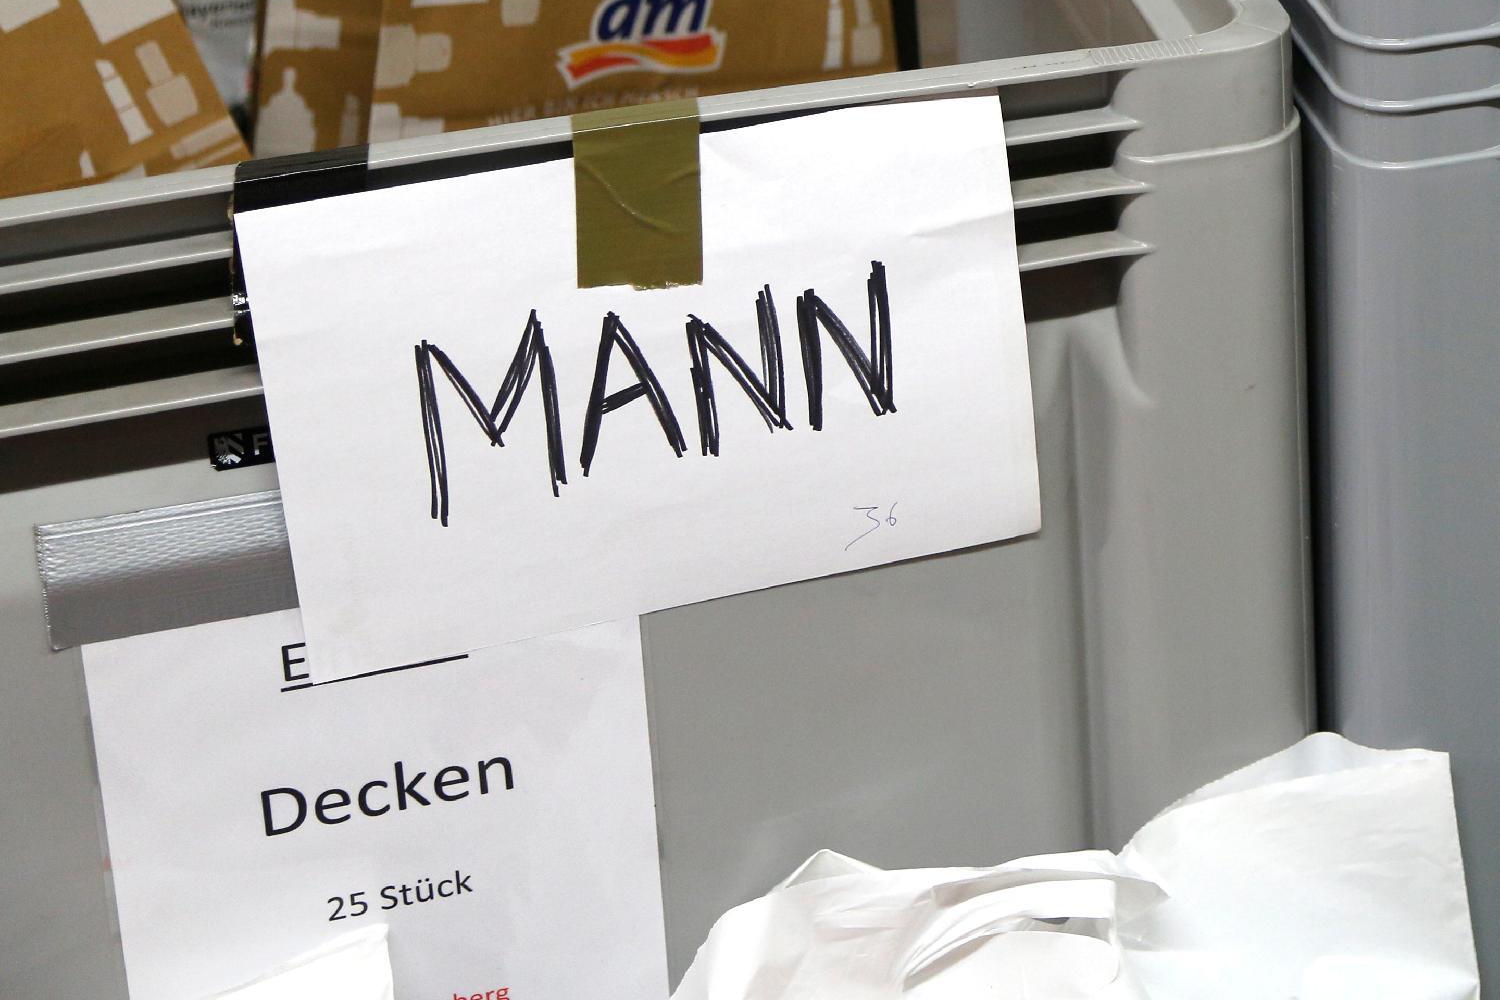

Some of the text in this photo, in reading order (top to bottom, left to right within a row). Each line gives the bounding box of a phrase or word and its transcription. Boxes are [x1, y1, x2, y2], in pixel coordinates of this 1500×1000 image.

[414, 259, 897, 527] MANN
[259, 754, 515, 837] Decken
[326, 869, 473, 922] 25 Stück
